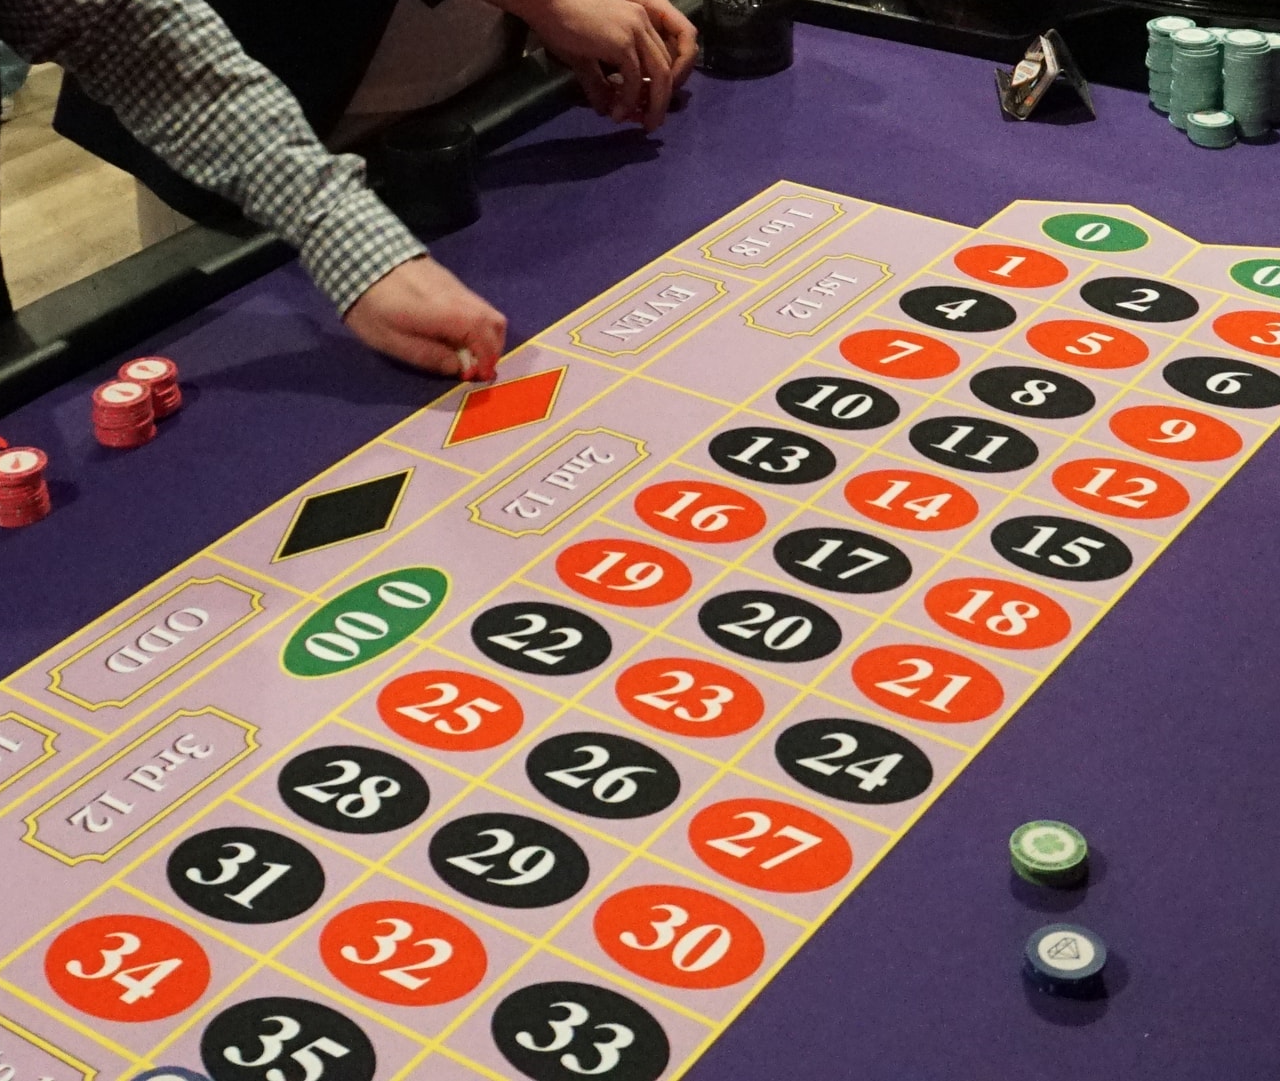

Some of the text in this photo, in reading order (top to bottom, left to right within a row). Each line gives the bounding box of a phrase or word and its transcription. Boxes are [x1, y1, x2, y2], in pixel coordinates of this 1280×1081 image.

[728, 208, 814, 257] 1 to 18
[1074, 222, 1112, 243] 0
[990, 256, 1026, 277] 1
[601, 284, 699, 341] EVEN
[777, 272, 858, 319] 1st 12
[935, 298, 978, 321] 4
[1115, 288, 1160, 313] 2
[879, 339, 923, 364] 7
[1065, 332, 1114, 355] 5
[795, 384, 874, 420] 10
[1010, 379, 1057, 406] 8
[1205, 371, 1253, 395] 6
[728, 436, 810, 473] 13
[930, 425, 1009, 464] 11
[1151, 419, 1197, 444] 9
[504, 446, 615, 519] 2nd 12
[869, 480, 952, 521] 14
[1076, 467, 1158, 509] 12
[657, 491, 741, 532] 16
[579, 551, 664, 591] 19
[795, 539, 890, 580] 17
[1011, 525, 1106, 568] 15
[304, 580, 432, 662] 0 00
[717, 602, 813, 651] 20
[949, 589, 1040, 636] 18
[105, 607, 210, 674] ODD
[487, 613, 583, 665] 22
[396, 682, 502, 735] 25
[634, 670, 734, 722] 23
[875, 658, 971, 712] 21
[66, 732, 215, 834] 3rd 12
[544, 745, 657, 803] 26
[795, 732, 904, 792] 24
[293, 759, 401, 819] 28
[446, 828, 556, 886] 29
[706, 811, 822, 870] 27
[185, 842, 291, 909] 31
[340, 918, 453, 990] 32
[619, 904, 731, 972] 30
[66, 932, 182, 1004] 34
[223, 1015, 350, 1081] 35
[515, 1001, 635, 1075] 33
